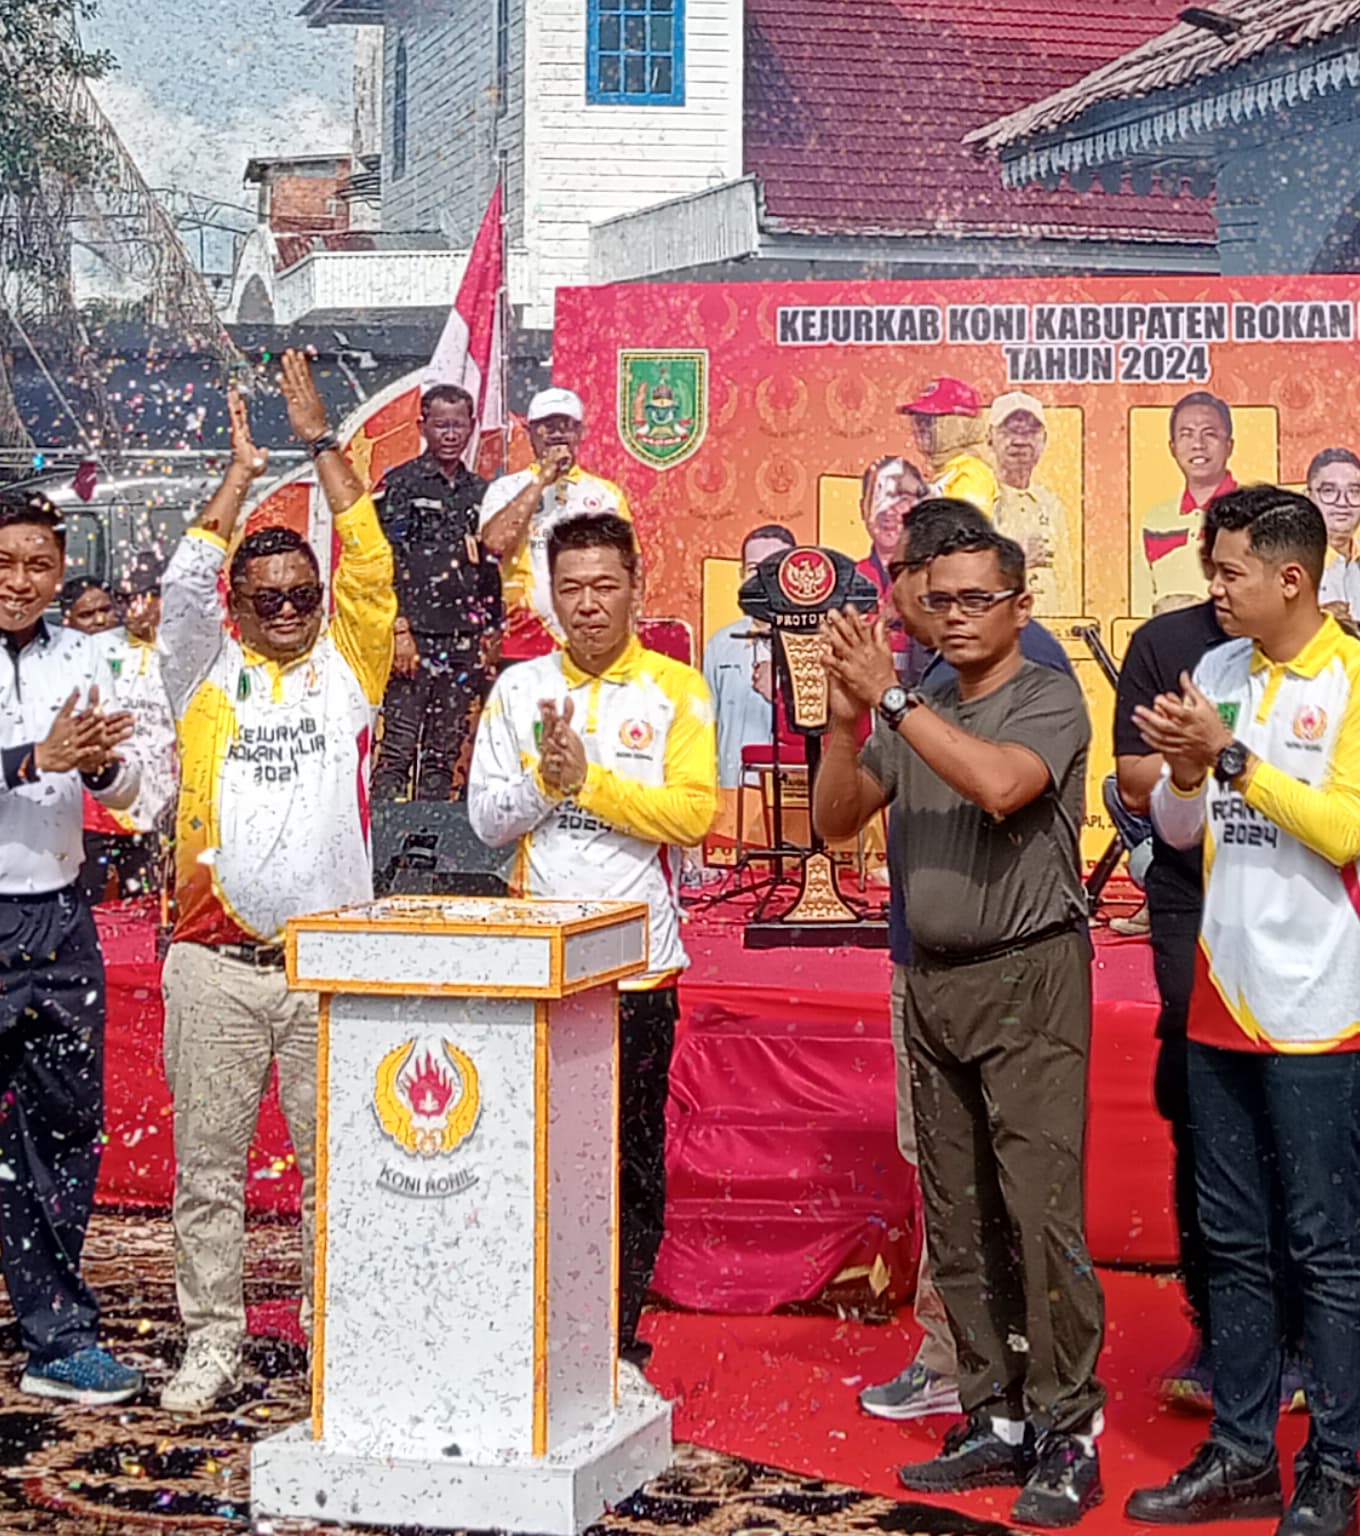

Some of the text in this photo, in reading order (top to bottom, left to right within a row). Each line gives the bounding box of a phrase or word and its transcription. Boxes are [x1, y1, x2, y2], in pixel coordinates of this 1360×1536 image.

[779, 309, 940, 342] KEJURKAB
[947, 307, 1027, 341] KONI
[1034, 306, 1226, 340] KABUPATEN
[1234, 304, 1351, 339] ROKAN
[1004, 346, 1208, 381] TAHUN 2024
[1223, 823, 1279, 848] 2024
[380, 1162, 421, 1194] KONI
